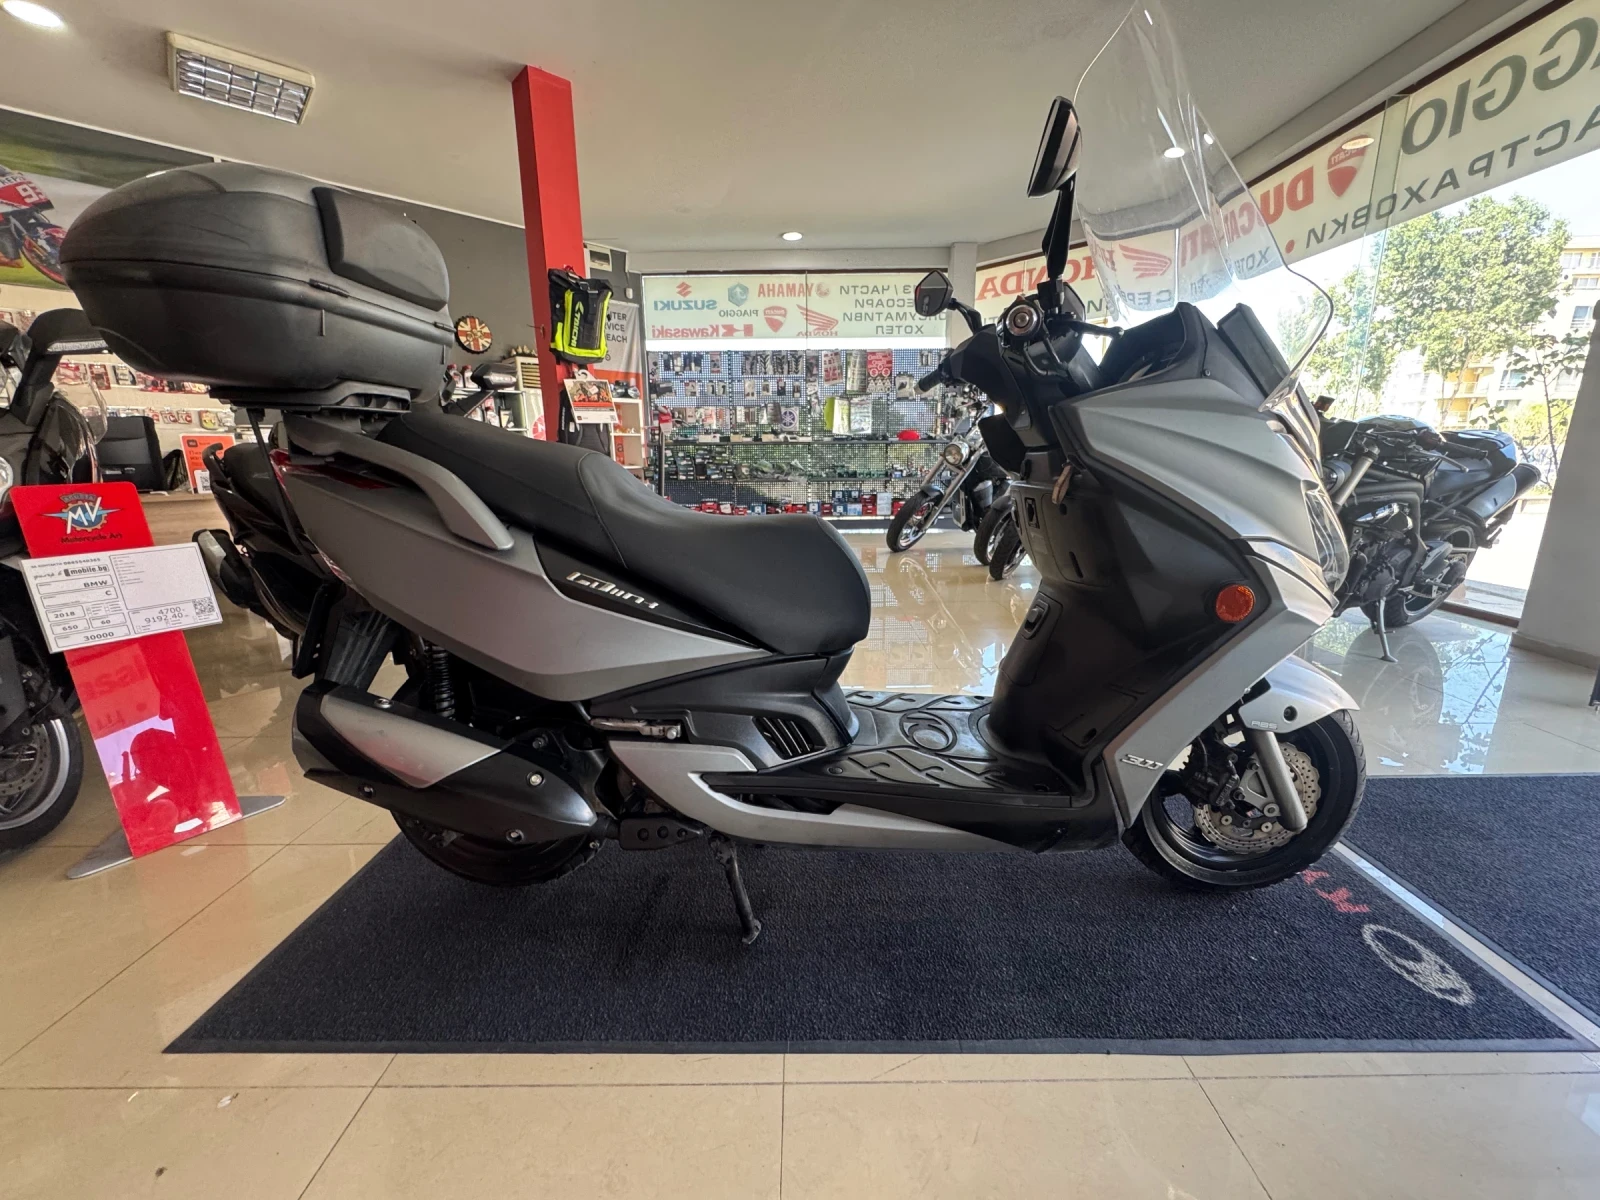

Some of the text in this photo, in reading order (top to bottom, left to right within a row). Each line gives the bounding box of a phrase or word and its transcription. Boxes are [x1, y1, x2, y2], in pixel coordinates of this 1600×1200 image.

[84, 579, 108, 588] BMW
[54, 611, 76, 619] 2018
[83, 631, 114, 641] 30000
